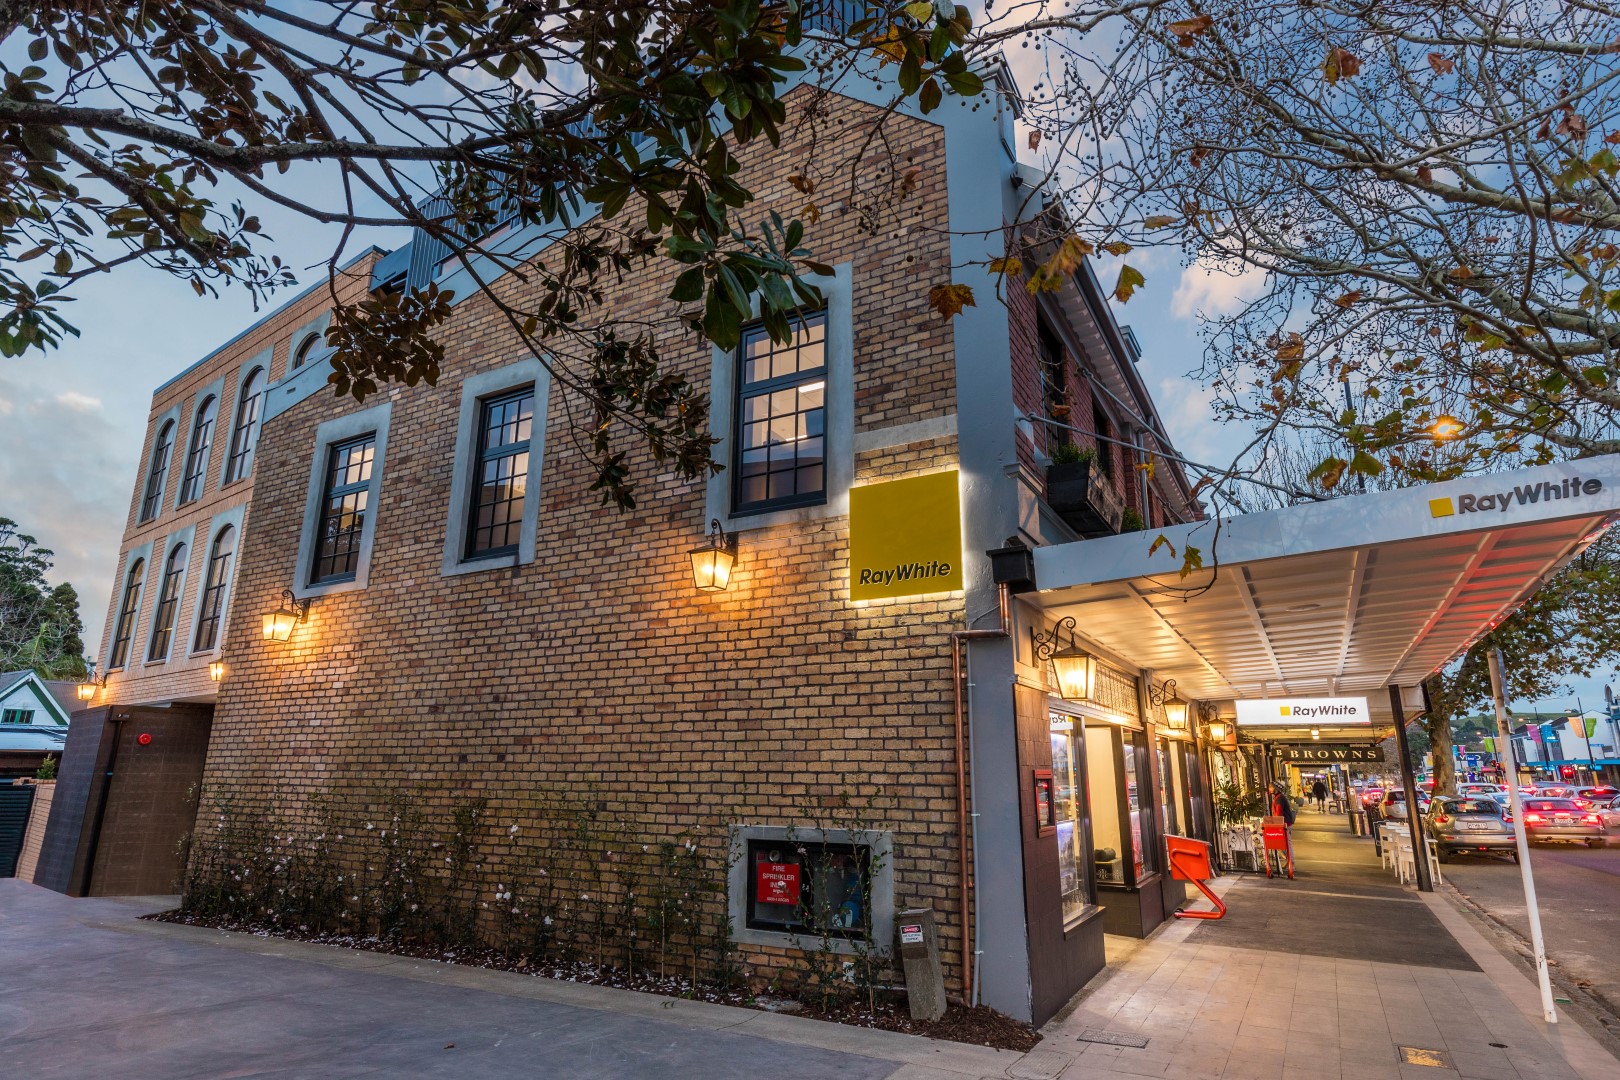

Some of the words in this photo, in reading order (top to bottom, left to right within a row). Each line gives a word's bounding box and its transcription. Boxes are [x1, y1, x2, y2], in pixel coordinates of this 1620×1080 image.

[1458, 476, 1602, 515] RayWhite
[859, 561, 952, 586] RayWhite
[1292, 705, 1357, 717] RayWhite
[1290, 750, 1377, 758] BROWNS
[762, 872, 795, 881] SPRINKLER
